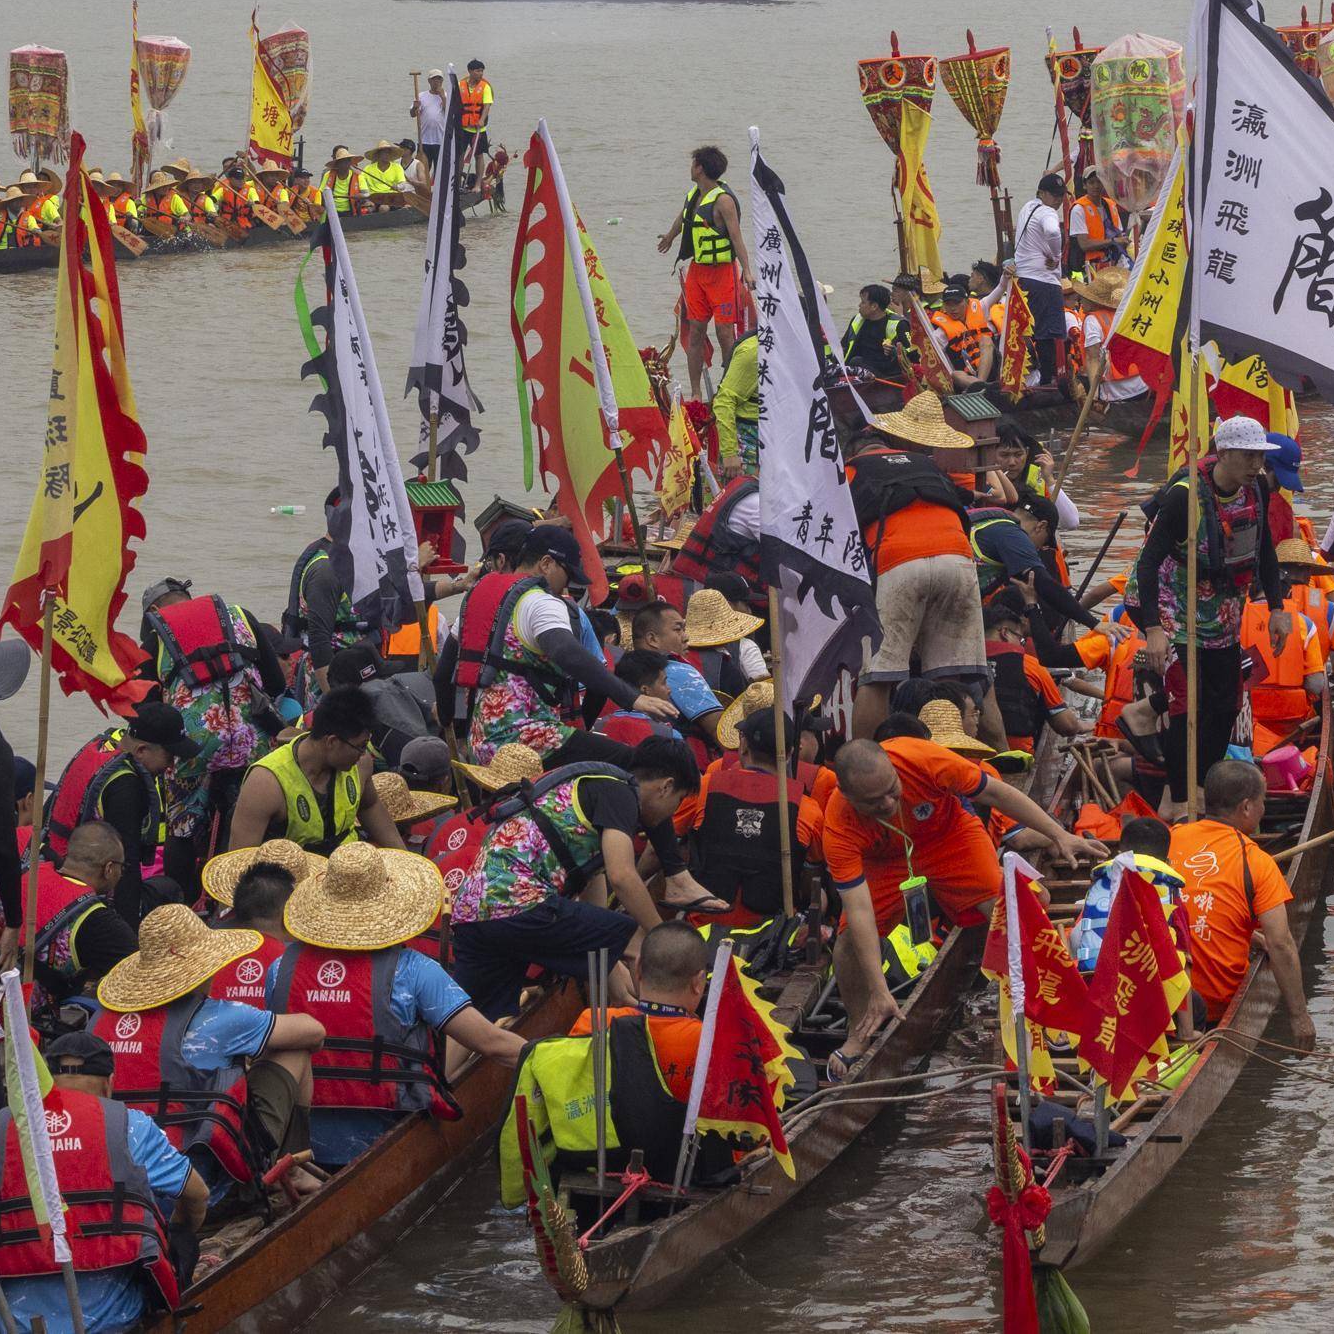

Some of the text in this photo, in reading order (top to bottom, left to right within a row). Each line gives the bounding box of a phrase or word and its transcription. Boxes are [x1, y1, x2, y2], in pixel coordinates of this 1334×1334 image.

[1204, 99, 1269, 285] 瀛洲飛龍
[306, 989, 351, 1003] YAMAHA
